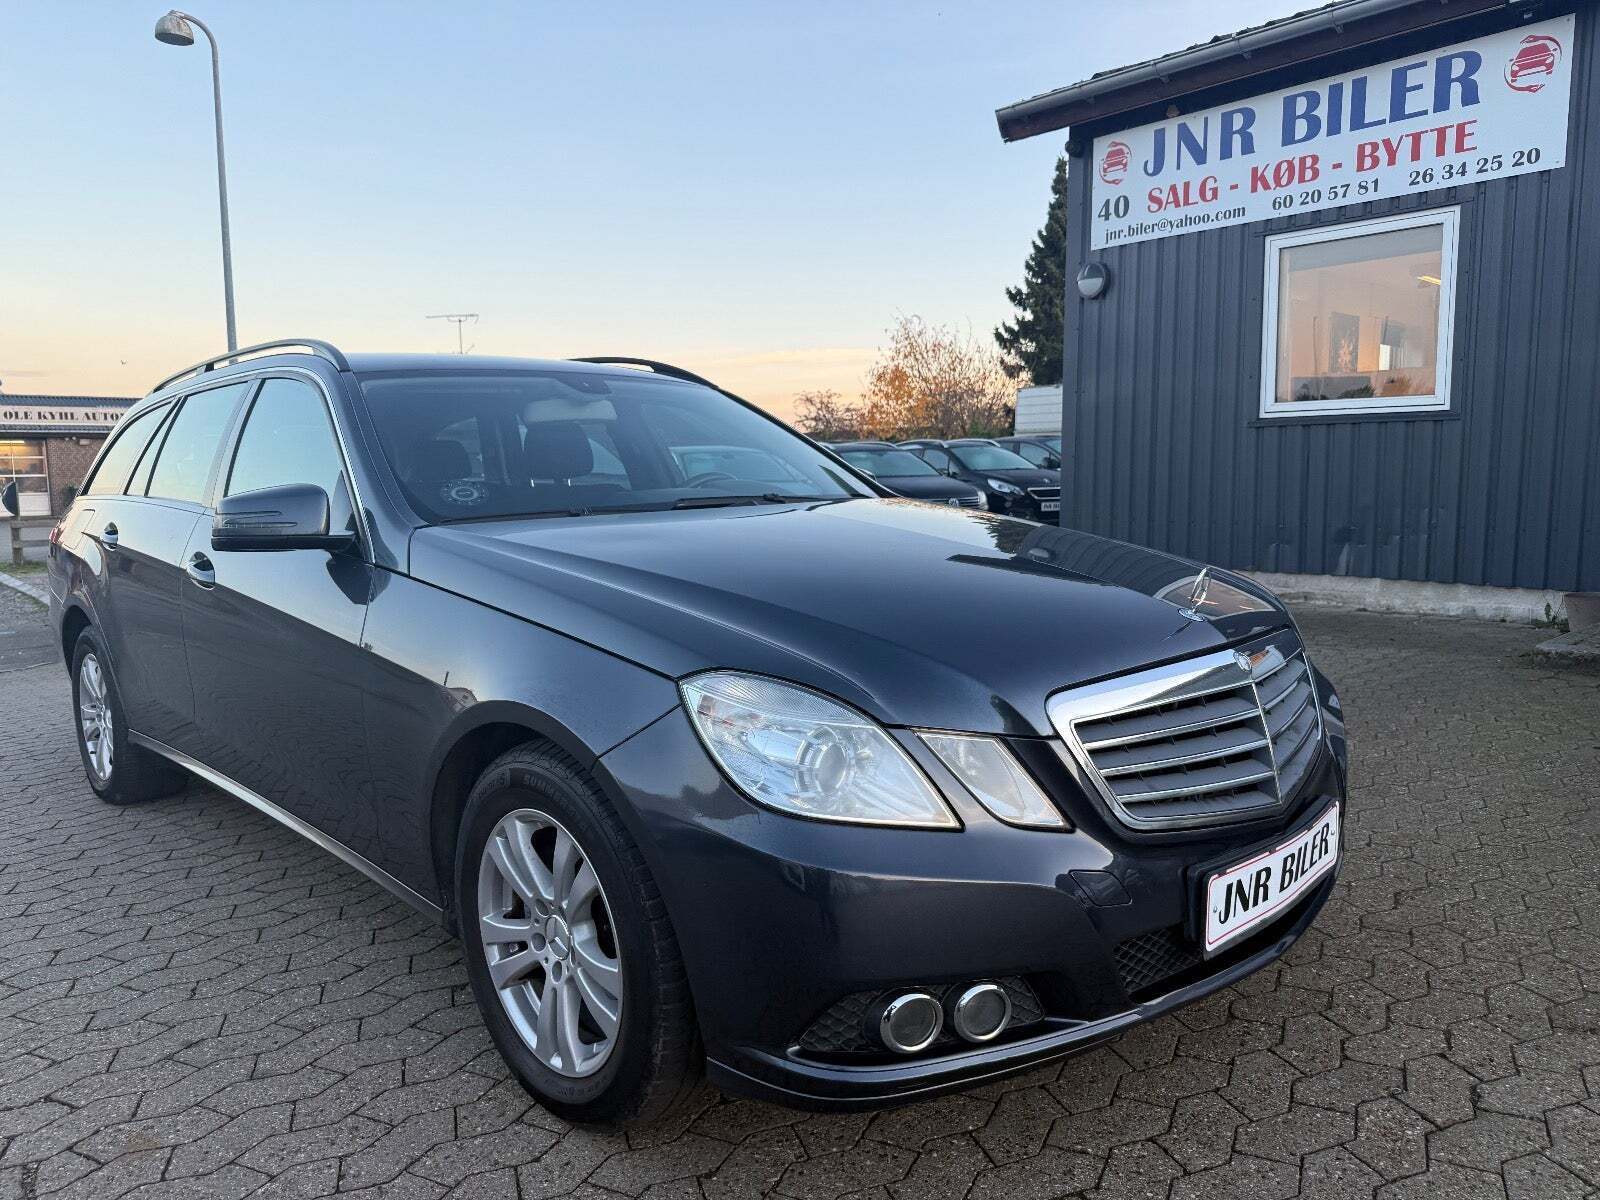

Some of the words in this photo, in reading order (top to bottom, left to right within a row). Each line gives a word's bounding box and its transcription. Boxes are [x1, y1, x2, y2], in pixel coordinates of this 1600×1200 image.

[1143, 106, 1256, 177] JNR
[1281, 50, 1483, 148] BILER
[1147, 176, 1219, 214] SALG
[1229, 183, 1239, 191] -
[1250, 154, 1320, 194] KØB
[1331, 162, 1343, 170] -
[1356, 119, 1478, 173] BYTTE
[1408, 168, 1434, 187] 26
[1441, 162, 1467, 180] 34
[1476, 155, 1503, 174] 25
[1511, 147, 1541, 167] 20
[1097, 195, 1130, 221] 40
[1271, 194, 1294, 211] 60
[1299, 188, 1322, 206] 20
[1327, 184, 1350, 201] 57
[1357, 178, 1379, 195] 81
[1104, 207, 1246, 244] jnr.biler@yahoo.com
[3, 410, 32, 420] OLE
[83, 412, 124, 422] AUTO
[1218, 866, 1272, 925] JNR
[1279, 822, 1330, 893] BILER
